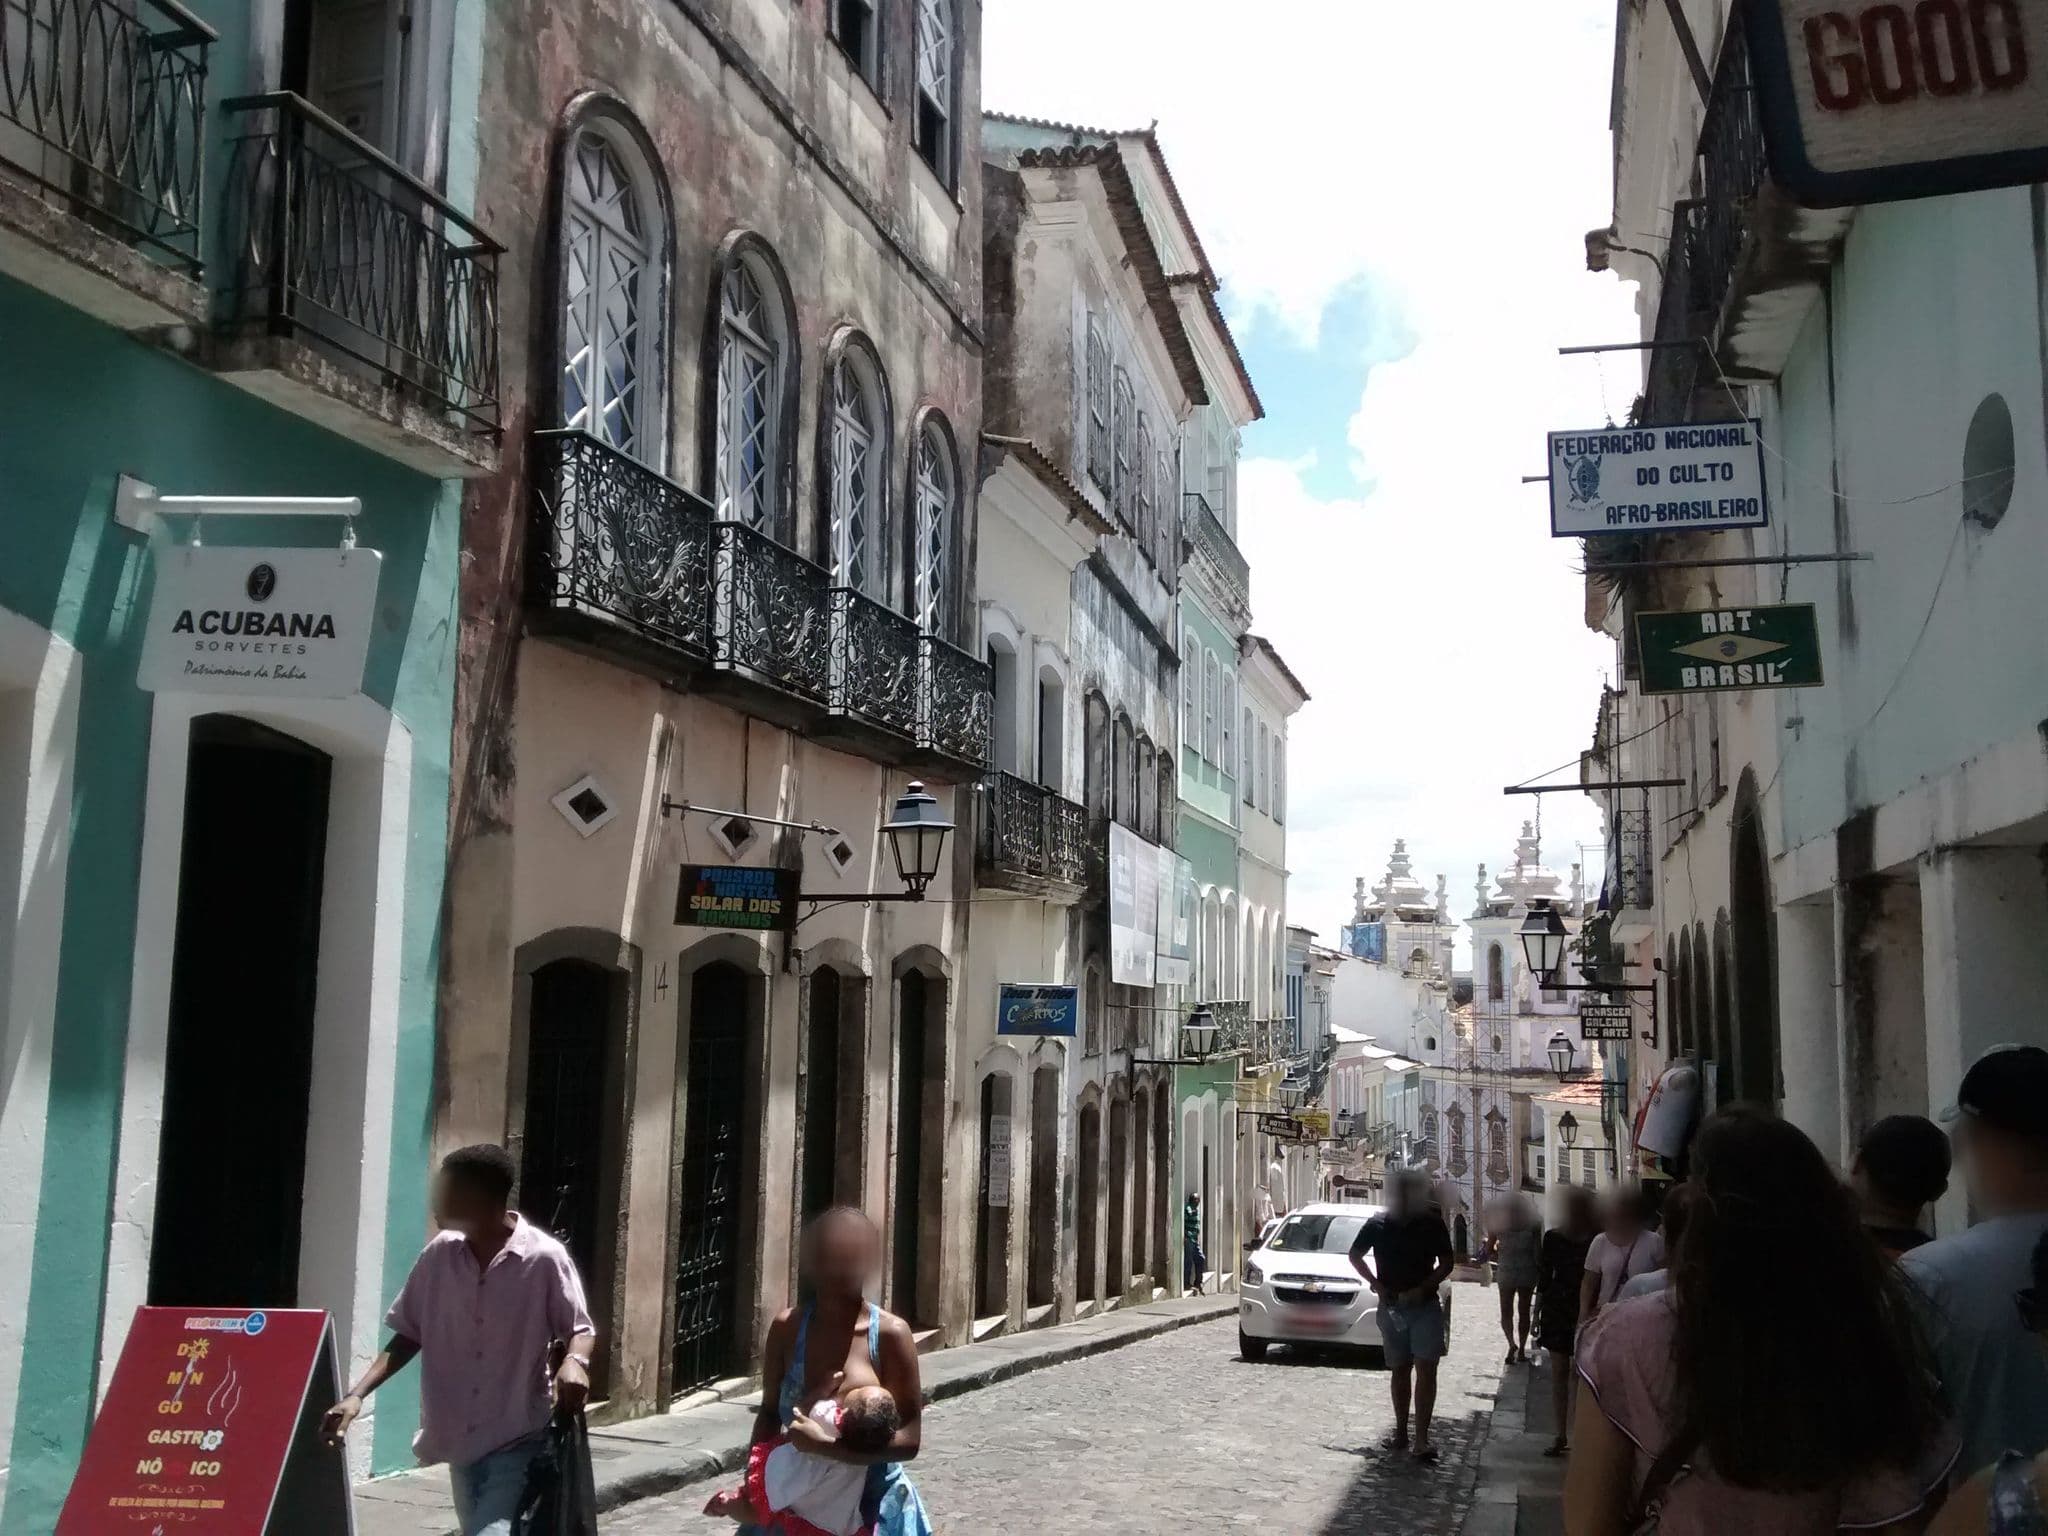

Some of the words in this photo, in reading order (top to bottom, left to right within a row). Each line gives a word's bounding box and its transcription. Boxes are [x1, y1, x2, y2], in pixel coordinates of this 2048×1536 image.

[1554, 431, 1655, 456] FEDERAÇÃO
[1665, 427, 1752, 450] NACIONAL
[1636, 466, 1660, 486] DO
[1669, 462, 1734, 484] CULTO
[1606, 497, 1759, 525] AFRO-BRASILEIRO
[171, 609, 336, 639] ACUBANA
[1701, 611, 1752, 634] ART
[195, 640, 307, 655] SORVETES
[1681, 662, 1783, 688] BRASIL
[690, 895, 744, 911] SOLAR
[749, 899, 781, 914] DOS
[654, 961, 668, 1003] 14
[1007, 1004, 1068, 1023] CRPOS
[1582, 1007, 1631, 1017] RENASCER
[1585, 1018, 1628, 1027] GALERIA
[1585, 1028, 1599, 1037] DE
[1602, 1028, 1629, 1037] ARTE
[1269, 1119, 1288, 1128] HOTEL
[158, 1401, 183, 1415] GO
